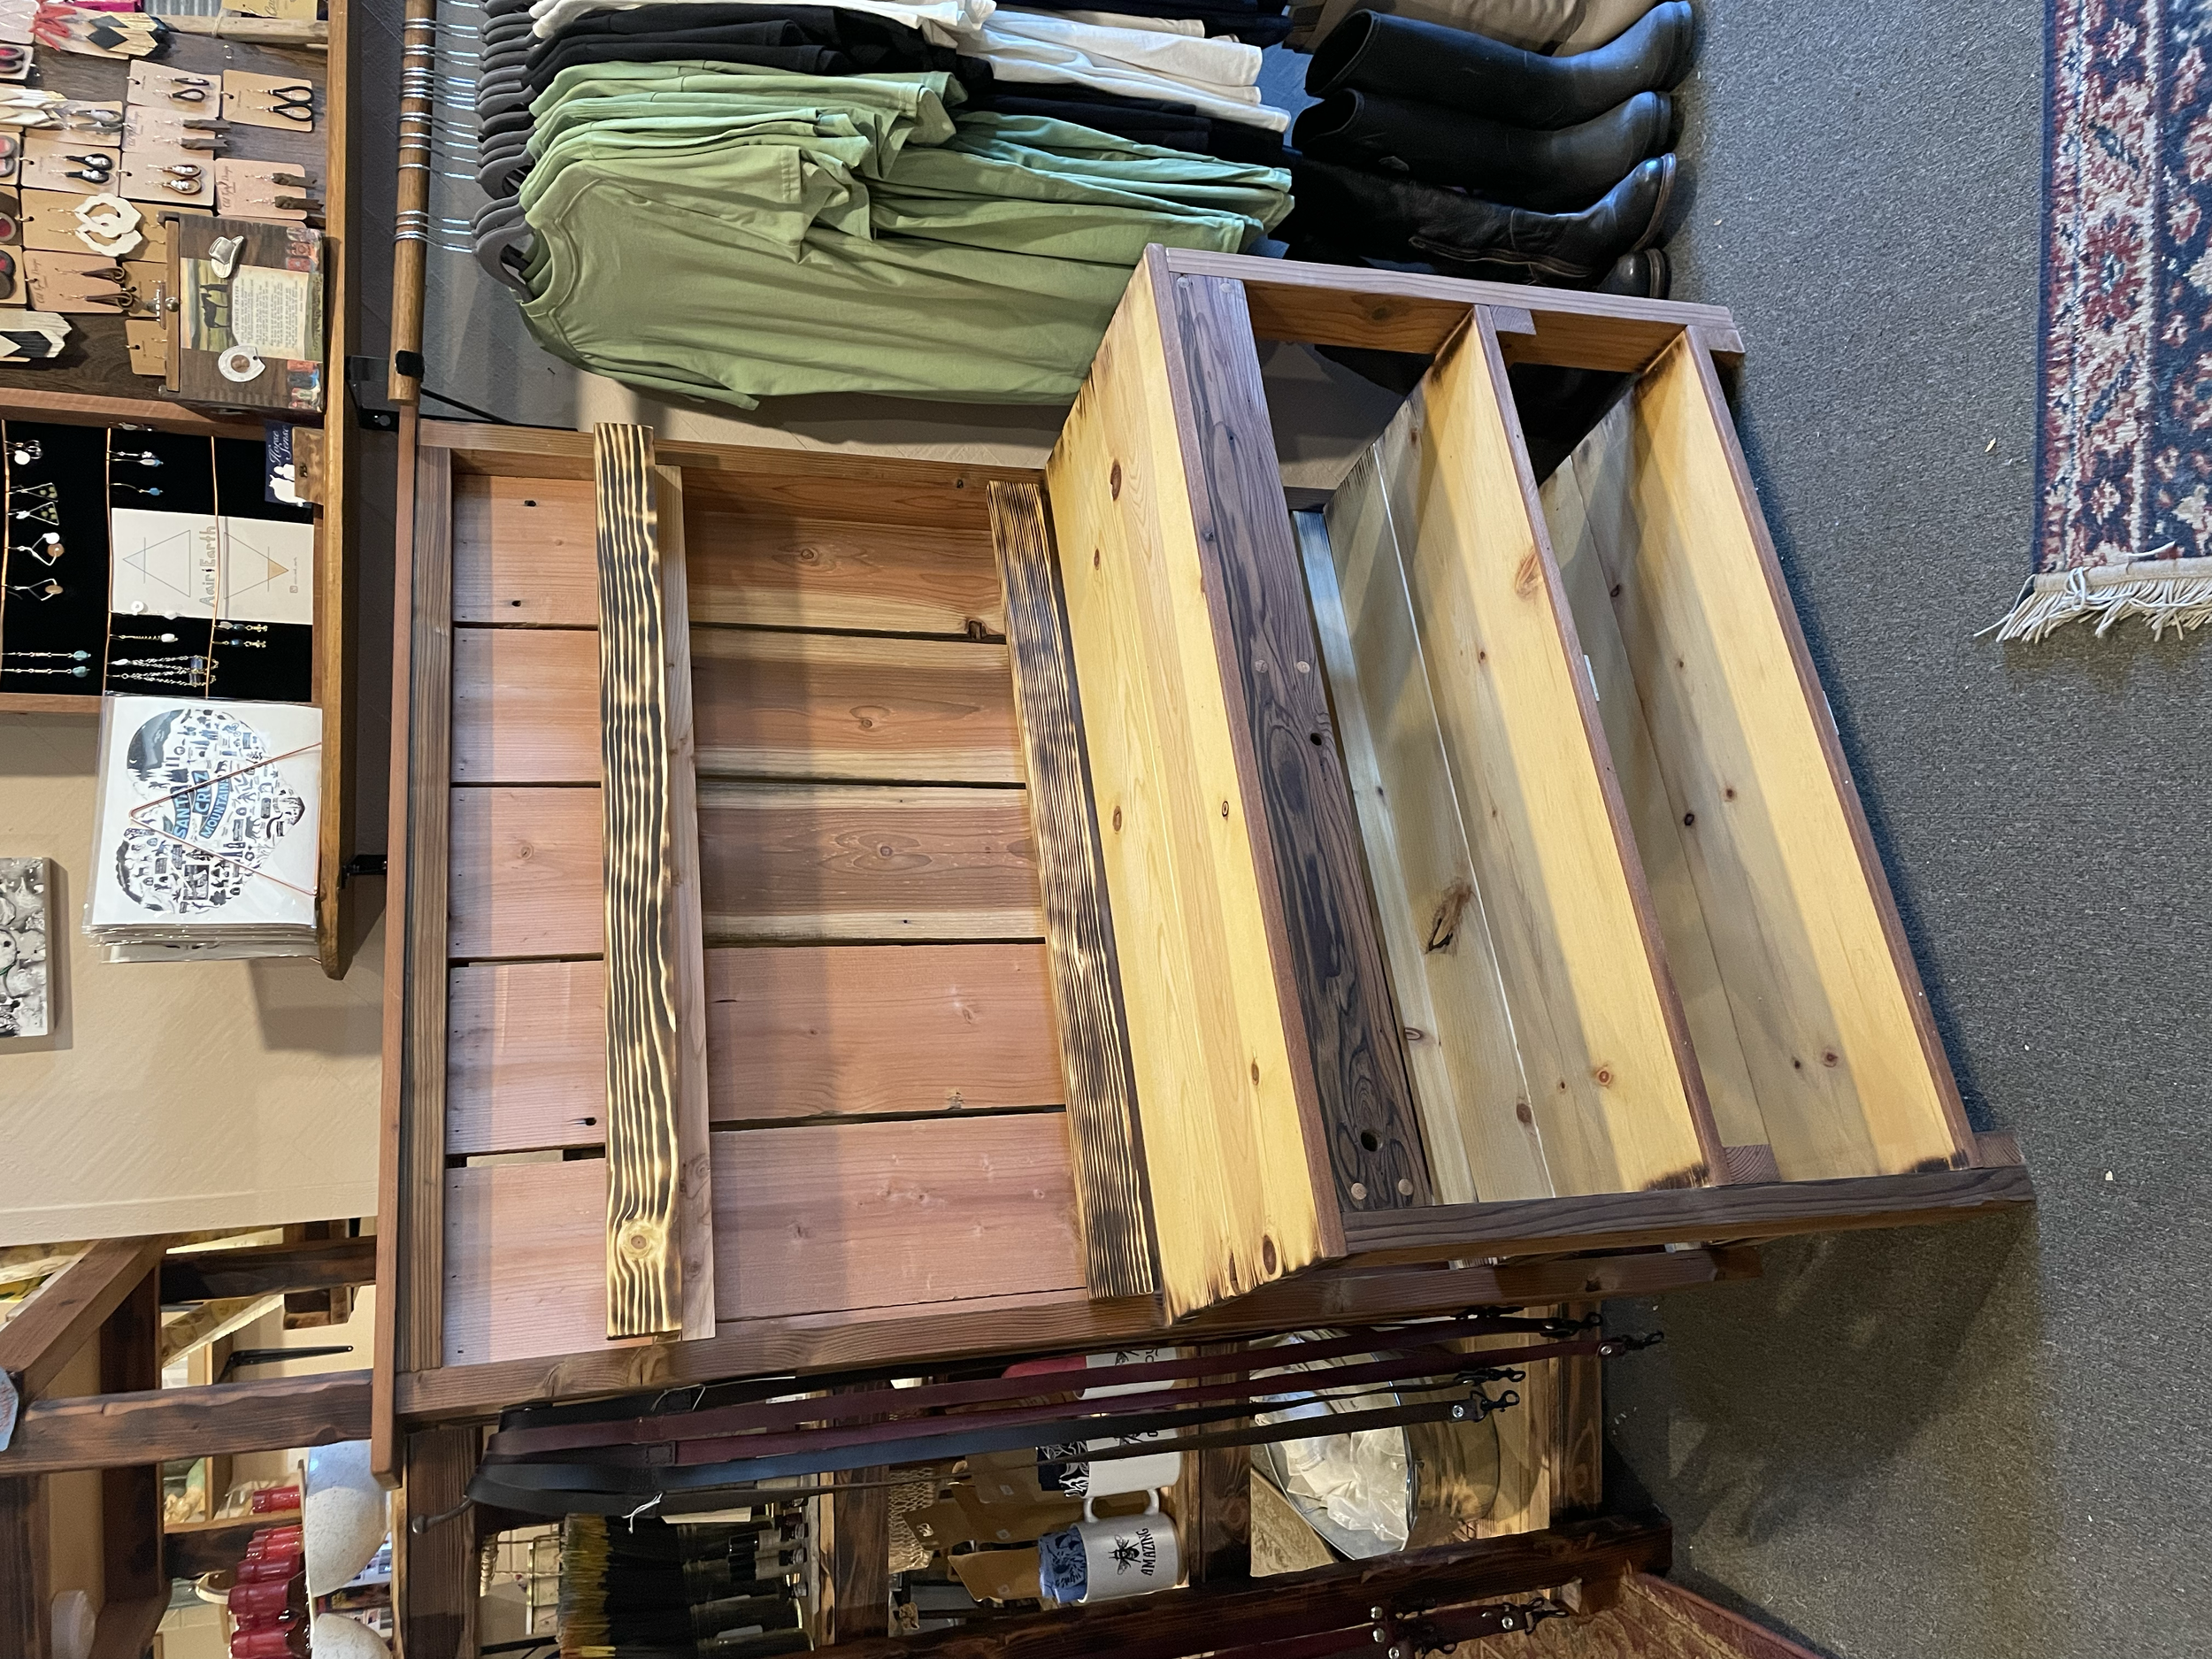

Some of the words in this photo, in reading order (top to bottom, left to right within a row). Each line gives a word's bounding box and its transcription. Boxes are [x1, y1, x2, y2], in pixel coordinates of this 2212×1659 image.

[268, 430, 282, 466] Horse
[279, 425, 292, 461] Sense
[199, 526, 216, 567] Earth
[199, 575, 215, 608] Aair
[194, 772, 211, 813] CRUZ
[200, 777, 230, 838] MOUNTAINS
[173, 790, 190, 840] SANTA
[1135, 1527, 1156, 1577] AMAZING
